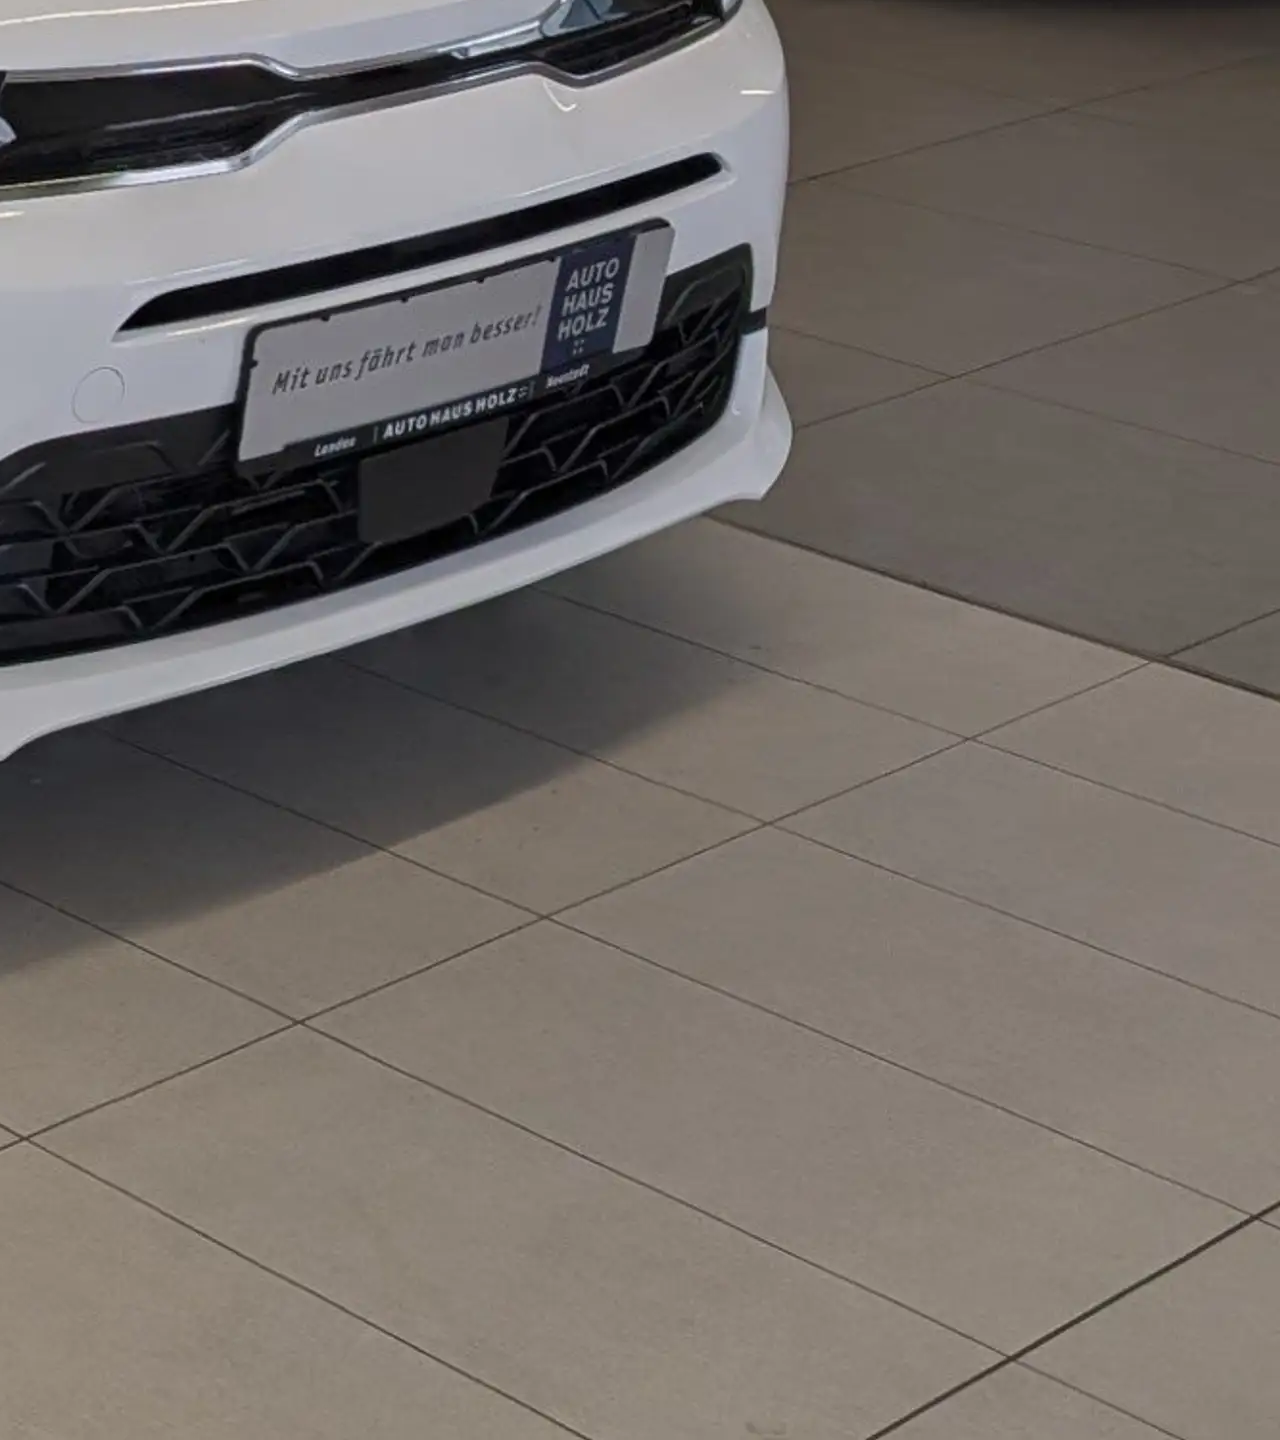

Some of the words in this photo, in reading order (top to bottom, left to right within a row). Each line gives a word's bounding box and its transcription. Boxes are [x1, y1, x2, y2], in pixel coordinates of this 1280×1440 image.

[564, 257, 620, 293] AUTO
[561, 282, 615, 317] HAUS
[557, 306, 610, 342] HOLZ
[271, 366, 311, 396] Mit
[314, 360, 353, 386] uns
[353, 340, 417, 382] fährt
[421, 331, 465, 358] man
[468, 303, 542, 345] besser!
[383, 413, 428, 440] AUTO
[429, 401, 474, 427] HAUS
[474, 386, 518, 414] HOLZ
